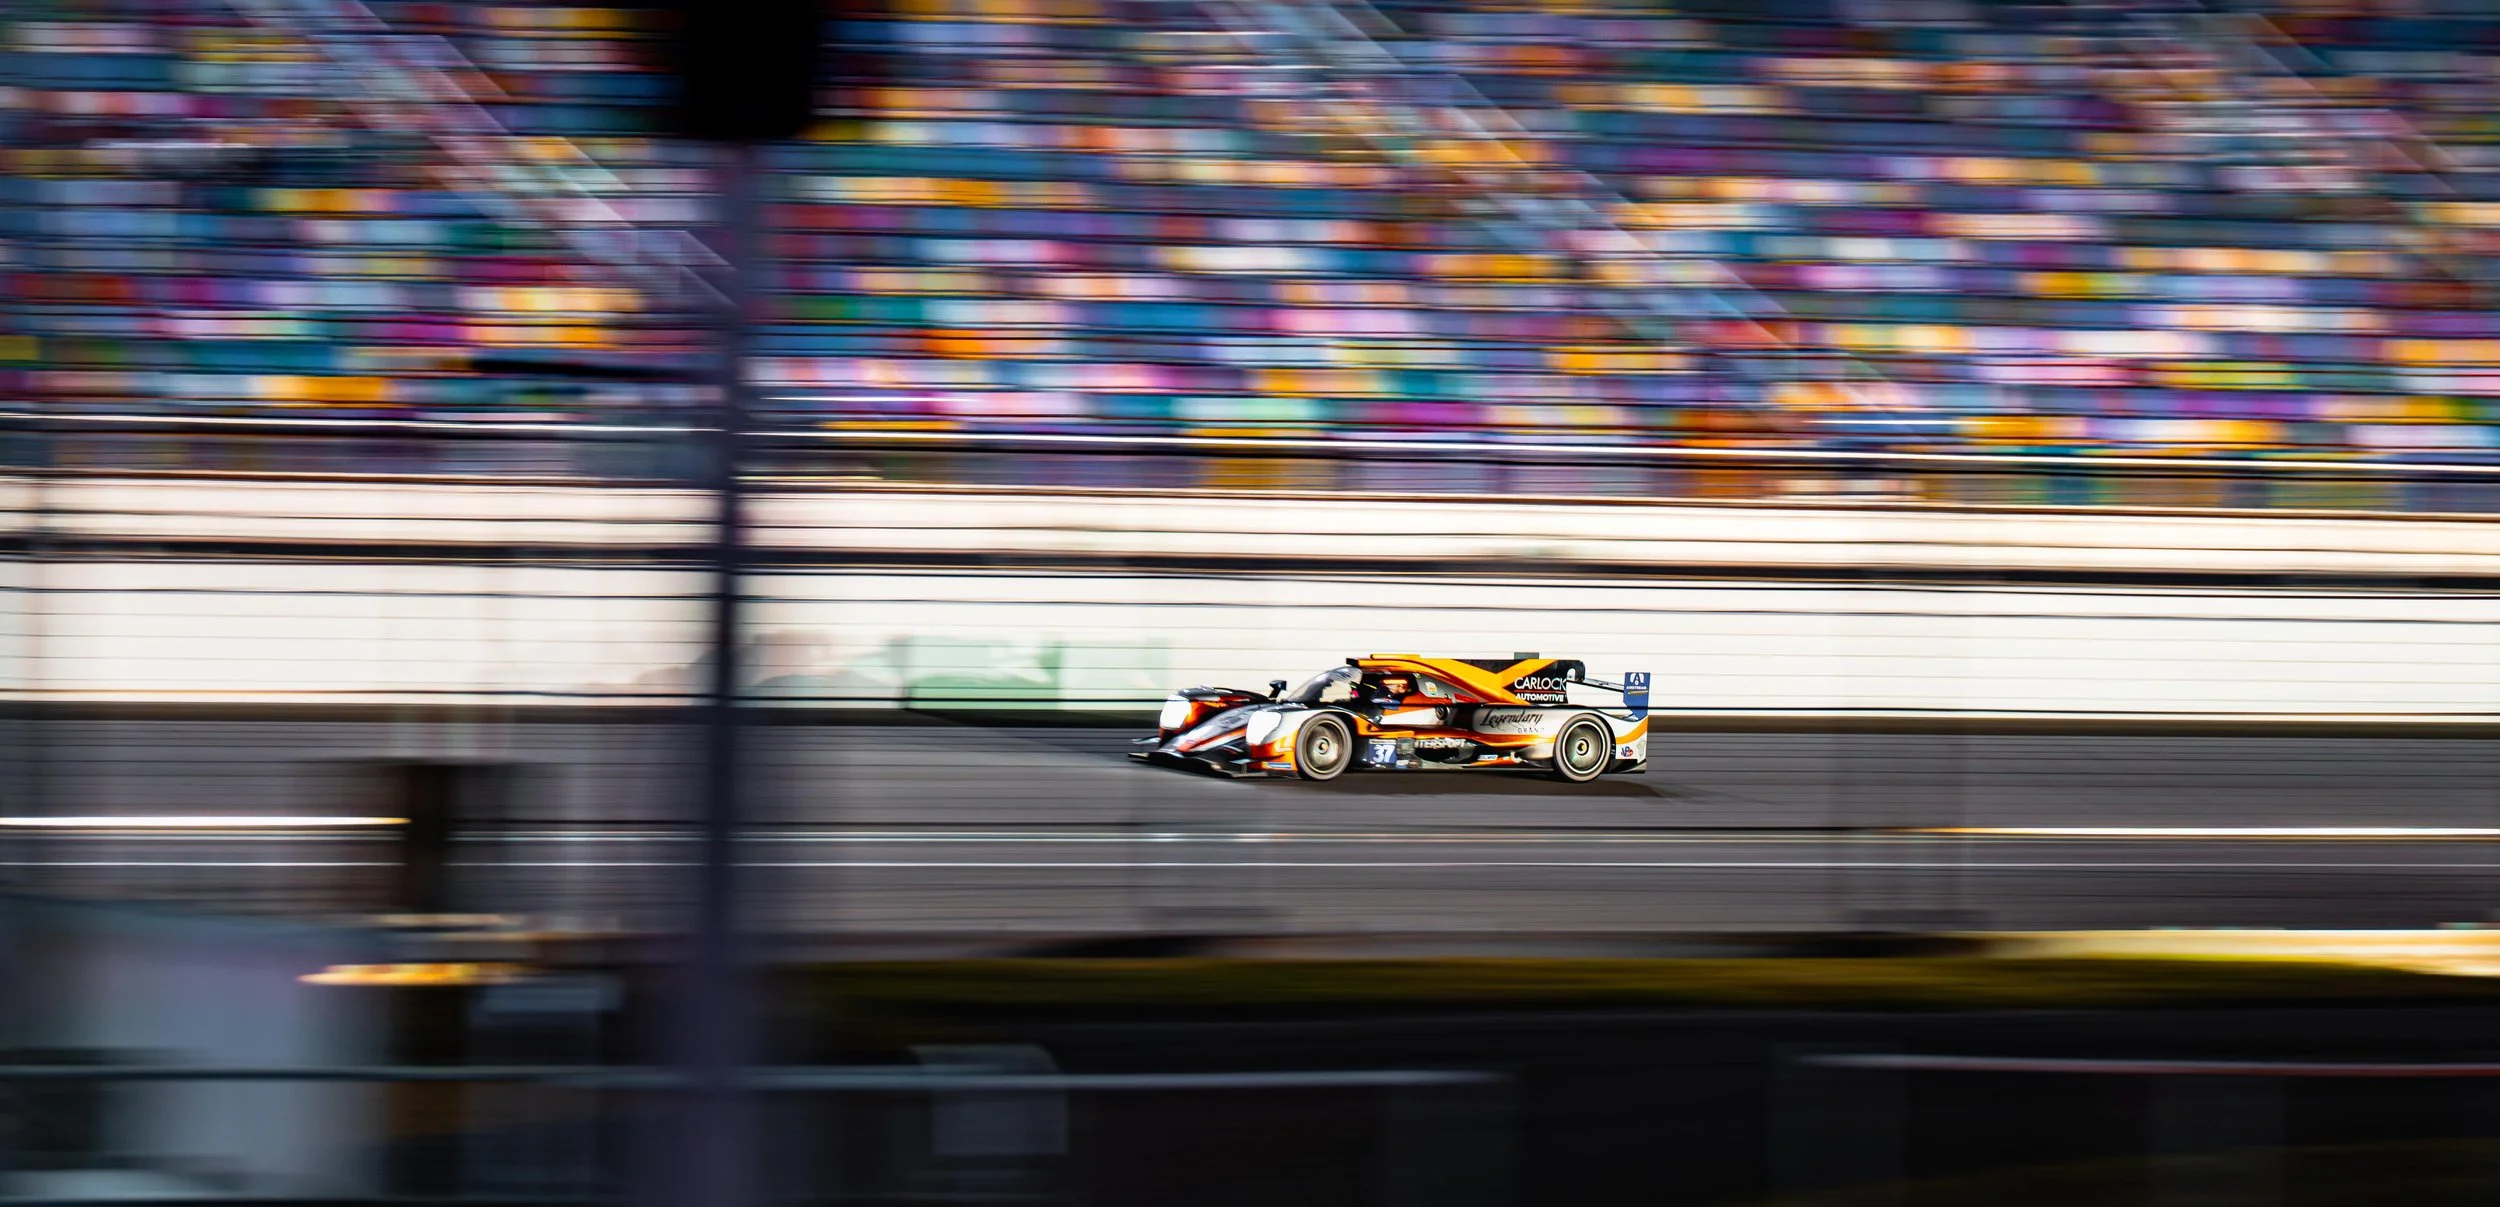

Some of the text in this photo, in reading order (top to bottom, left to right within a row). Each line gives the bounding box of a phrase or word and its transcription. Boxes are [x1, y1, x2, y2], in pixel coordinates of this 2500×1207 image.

[1514, 677, 1567, 691] CARLOCK
[1516, 692, 1565, 702] AUTOMOTIVE
[1480, 708, 1543, 728] Legendary
[1373, 744, 1395, 763] 37
